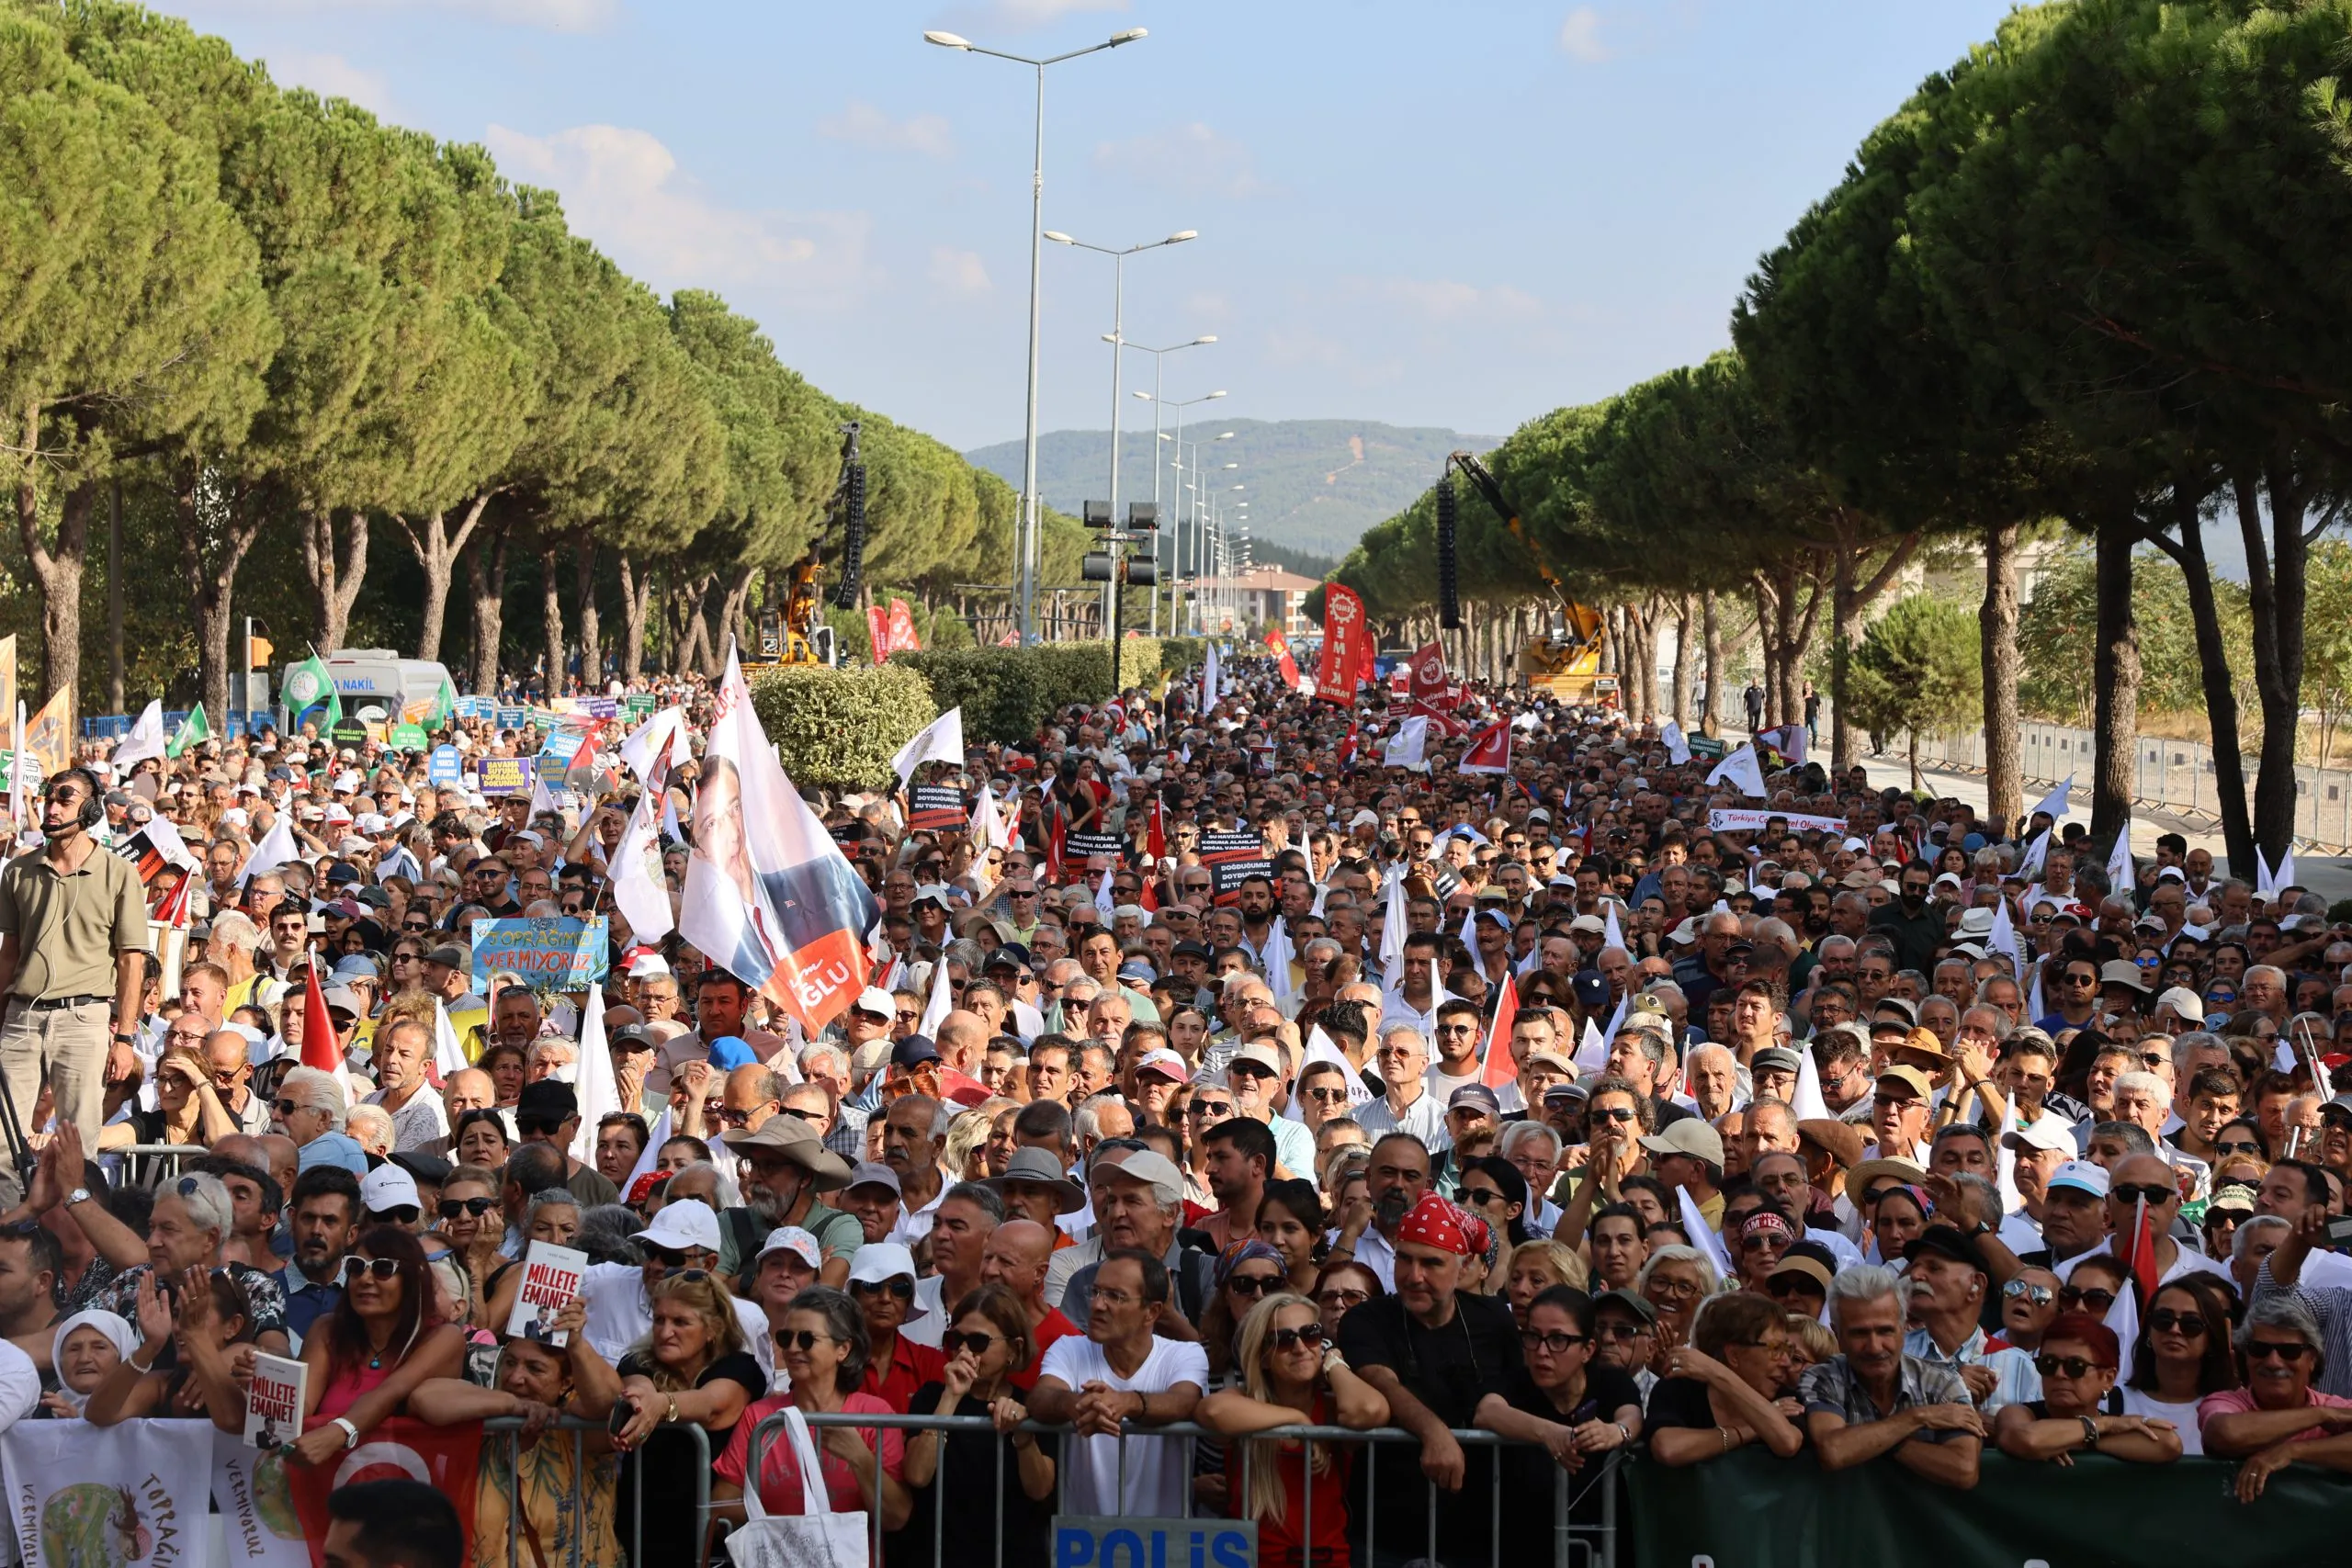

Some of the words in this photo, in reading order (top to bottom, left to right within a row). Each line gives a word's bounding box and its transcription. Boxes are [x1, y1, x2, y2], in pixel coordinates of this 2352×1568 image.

[343, 676, 375, 690] NAKİL
[487, 761, 519, 769] HAVAMA
[917, 787, 960, 795] DOĞDUĞUMUZ
[925, 803, 963, 811] TOPRAKLAR
[1727, 814, 1756, 823] Türkiye
[1068, 840, 1093, 849] KORUMA
[1068, 847, 1089, 855] DOĞAL
[1221, 863, 1271, 872] DOĞDUĞUMUZ
[526, 1263, 579, 1293] MİLLETE
[521, 1283, 575, 1311] EMANET
[251, 1374, 296, 1405] MİLLETE
[249, 1394, 295, 1424] EMANET
